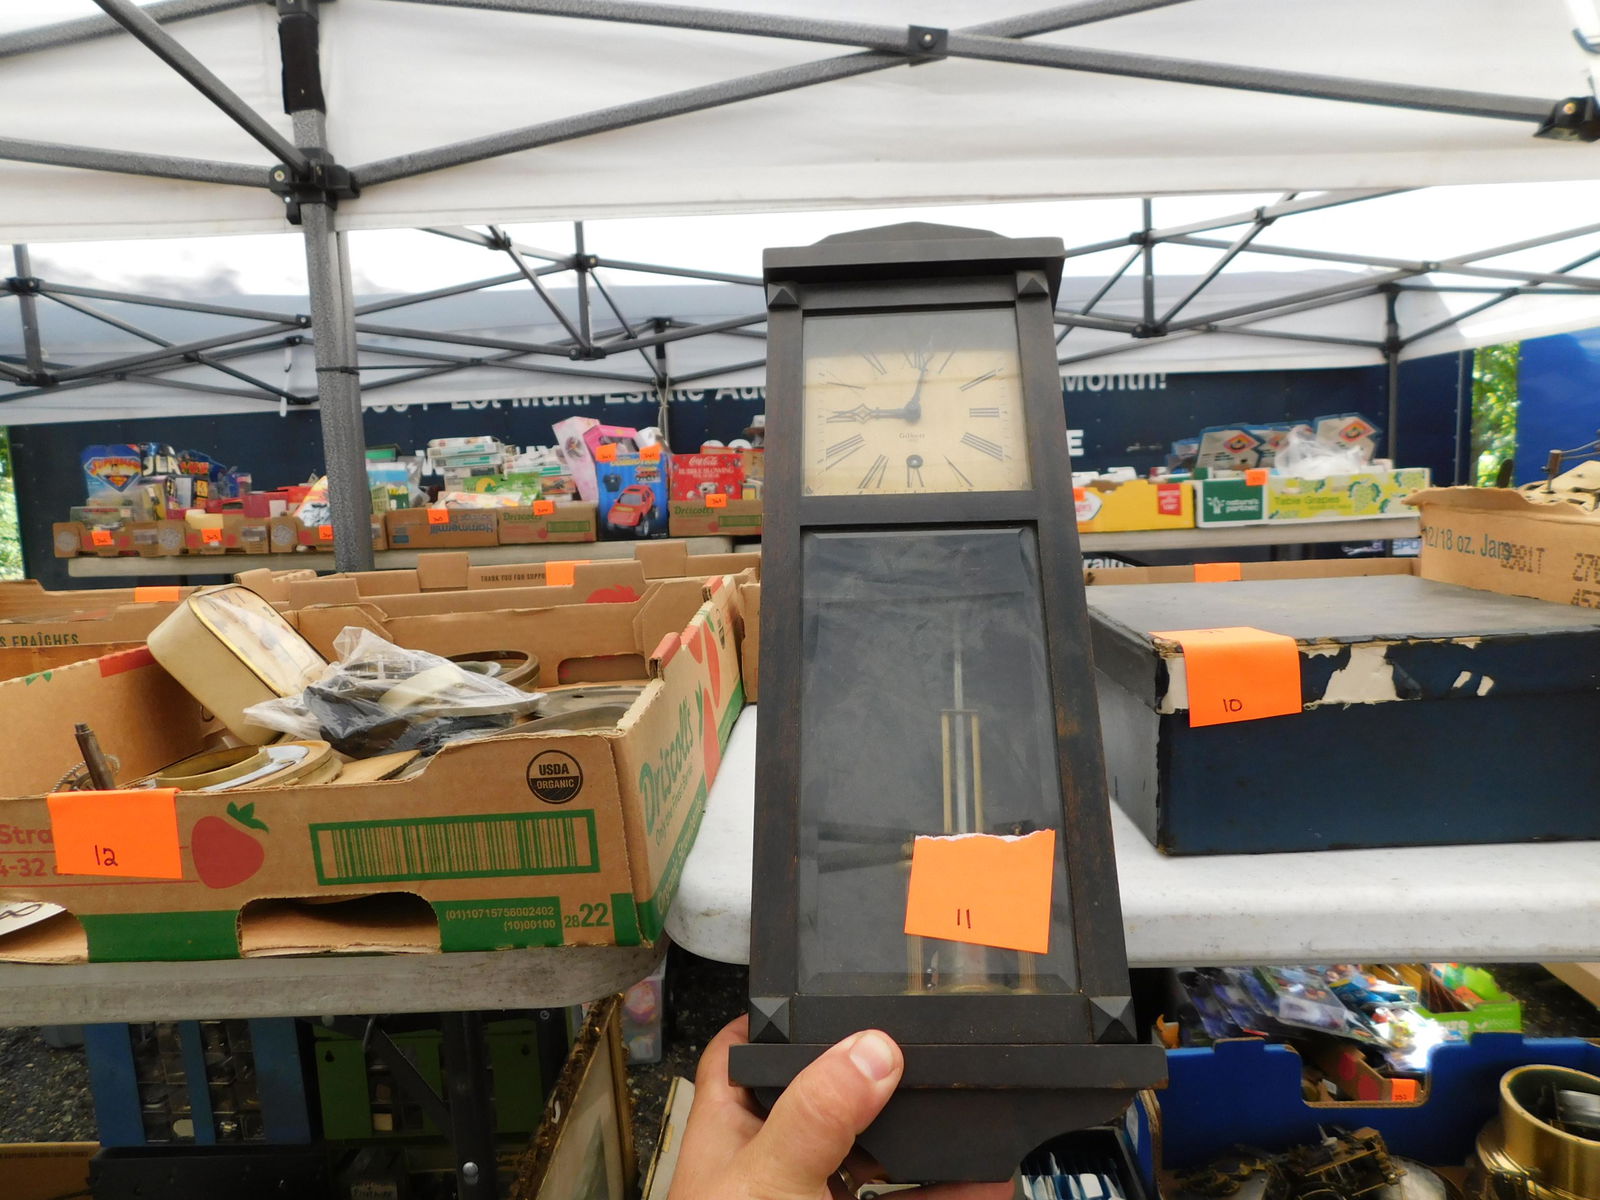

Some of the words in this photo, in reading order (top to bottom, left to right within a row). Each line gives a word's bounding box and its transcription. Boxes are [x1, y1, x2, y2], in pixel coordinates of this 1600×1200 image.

[1457, 535, 1475, 554] oz.
[1481, 534, 1513, 560] Jars
[1222, 698, 1243, 713] 10
[538, 763, 570, 776] USDA
[536, 778, 575, 789] ORGANIC
[94, 844, 119, 867] 12
[956, 908, 972, 929] 11
